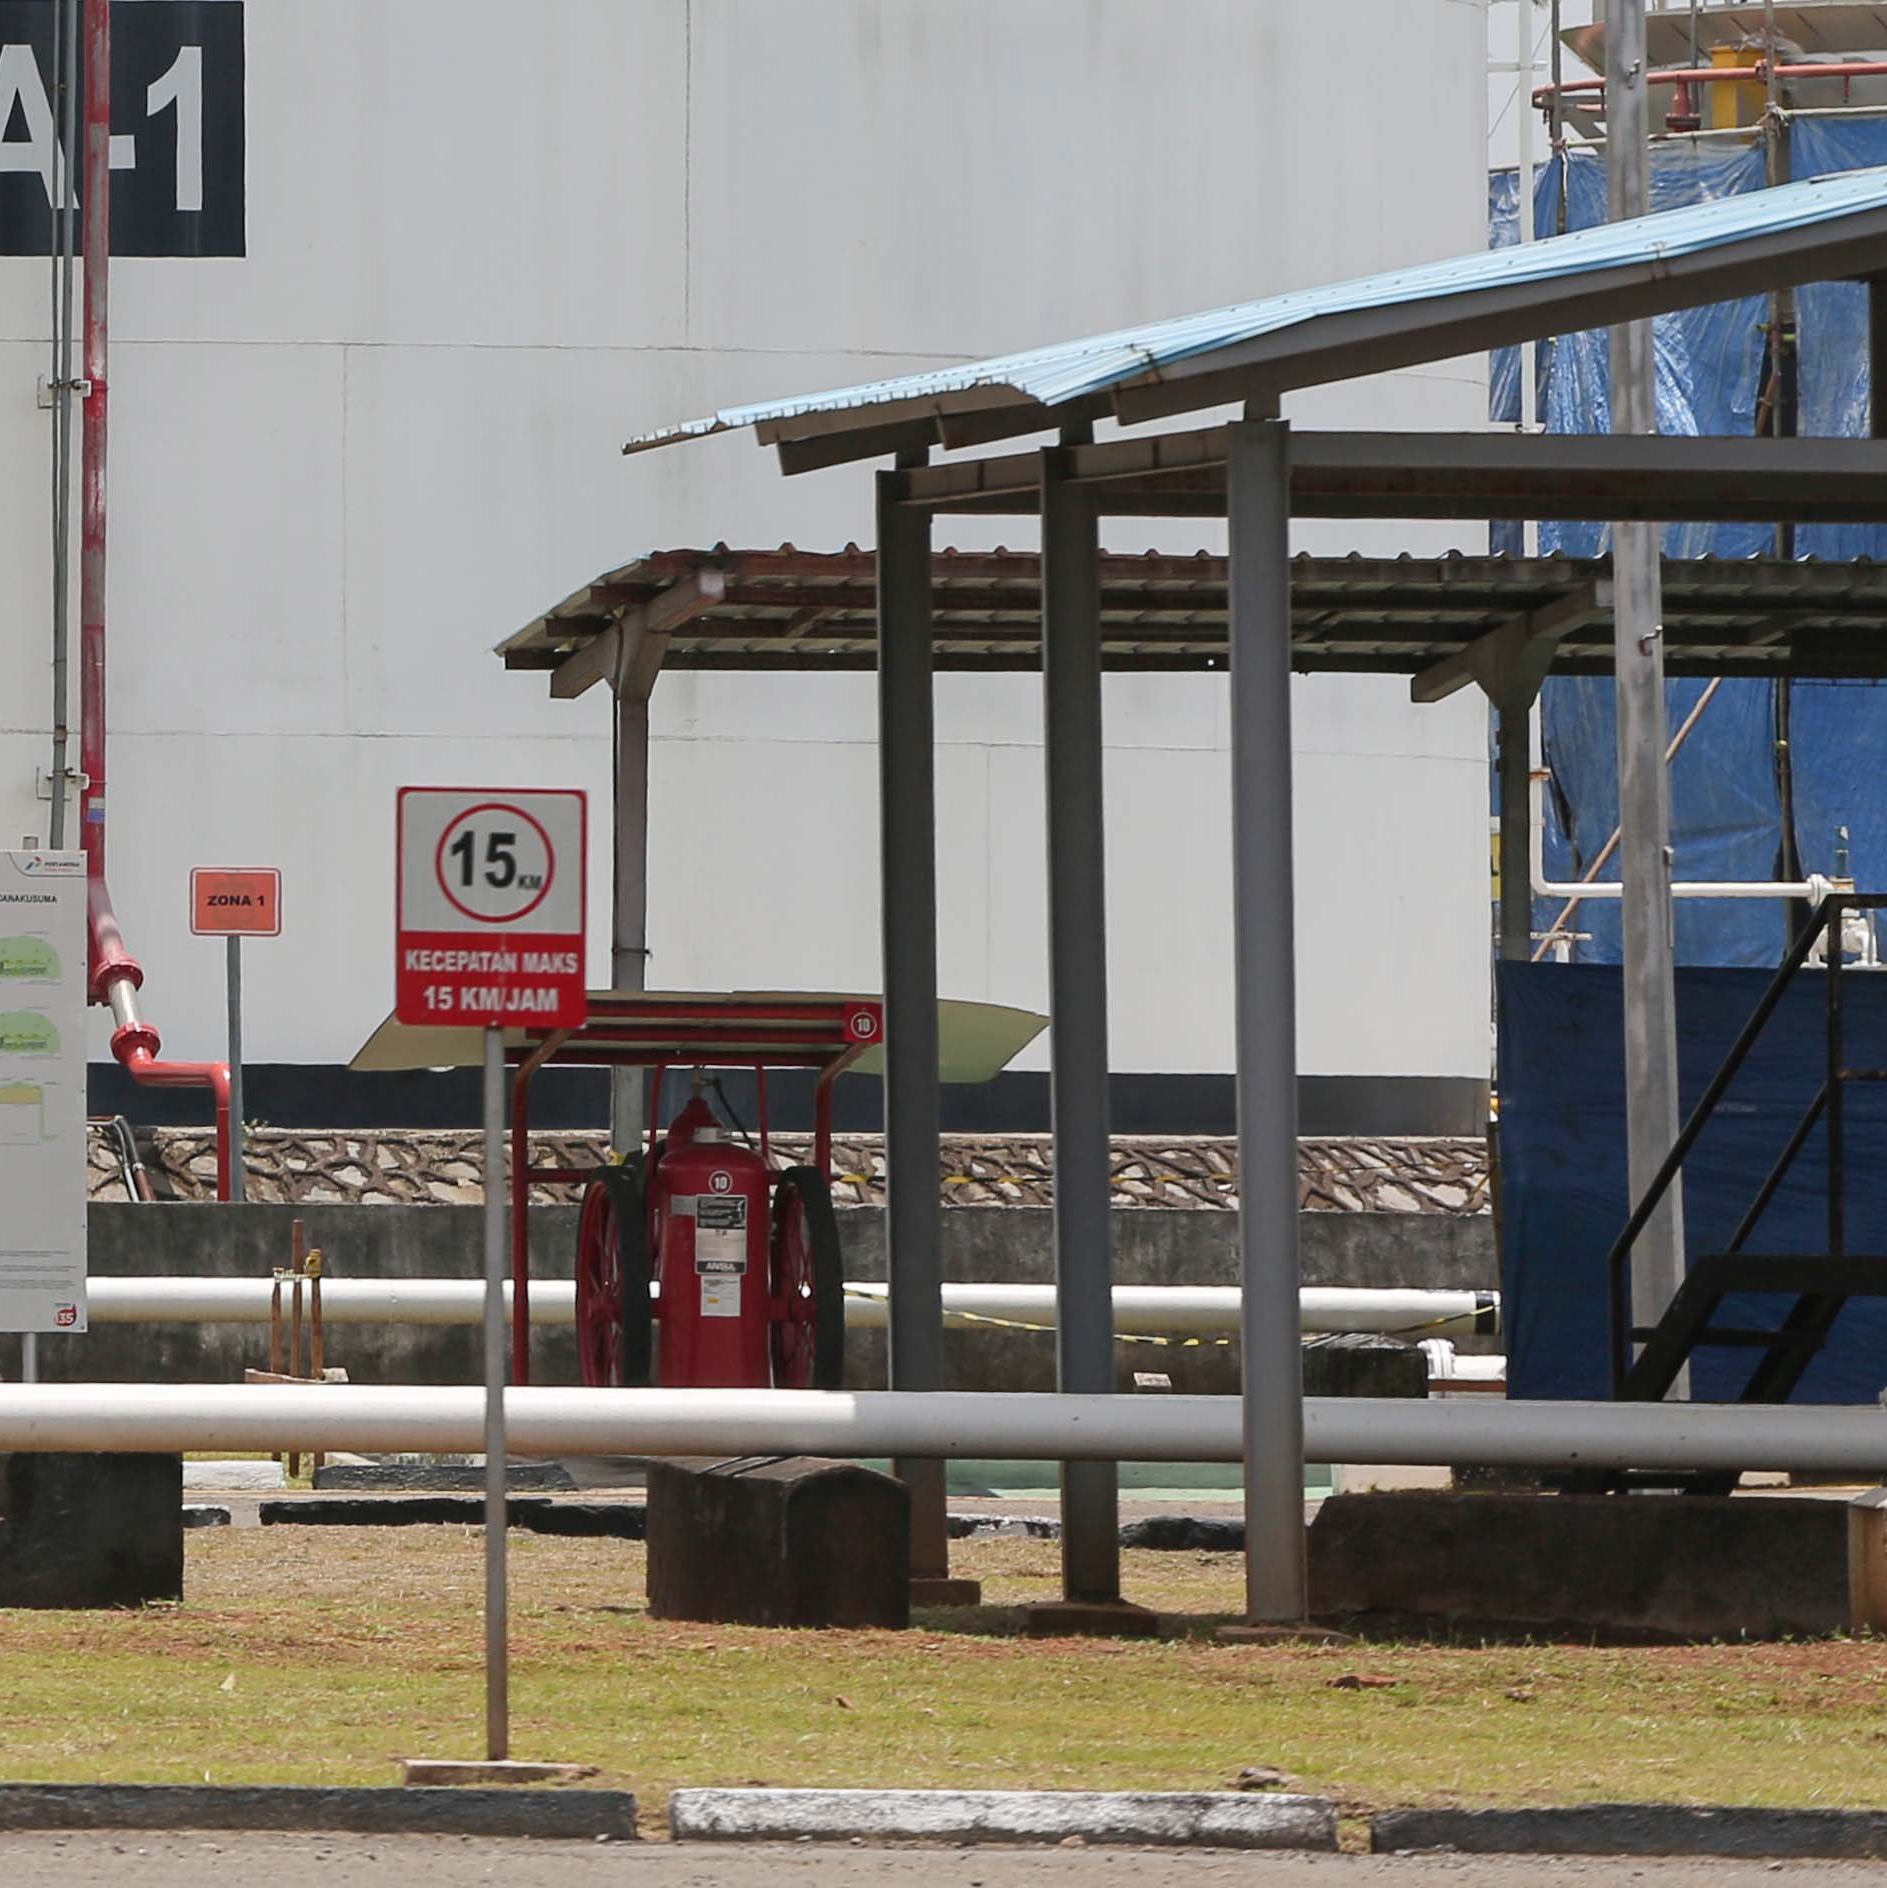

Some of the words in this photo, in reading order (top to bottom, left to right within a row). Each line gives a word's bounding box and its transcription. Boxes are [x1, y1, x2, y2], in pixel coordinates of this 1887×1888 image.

[449, 830, 517, 888] 15
[517, 875, 542, 890] KM
[207, 895, 252, 906] ZONA
[257, 895, 265, 906] 1
[405, 949, 516, 973] KECEPATAN
[522, 951, 578, 974] MAKS
[423, 987, 452, 1011] 15
[460, 987, 559, 1012] KM/JAM
[857, 1018, 870, 1032] 10
[714, 1176, 728, 1190] 10
